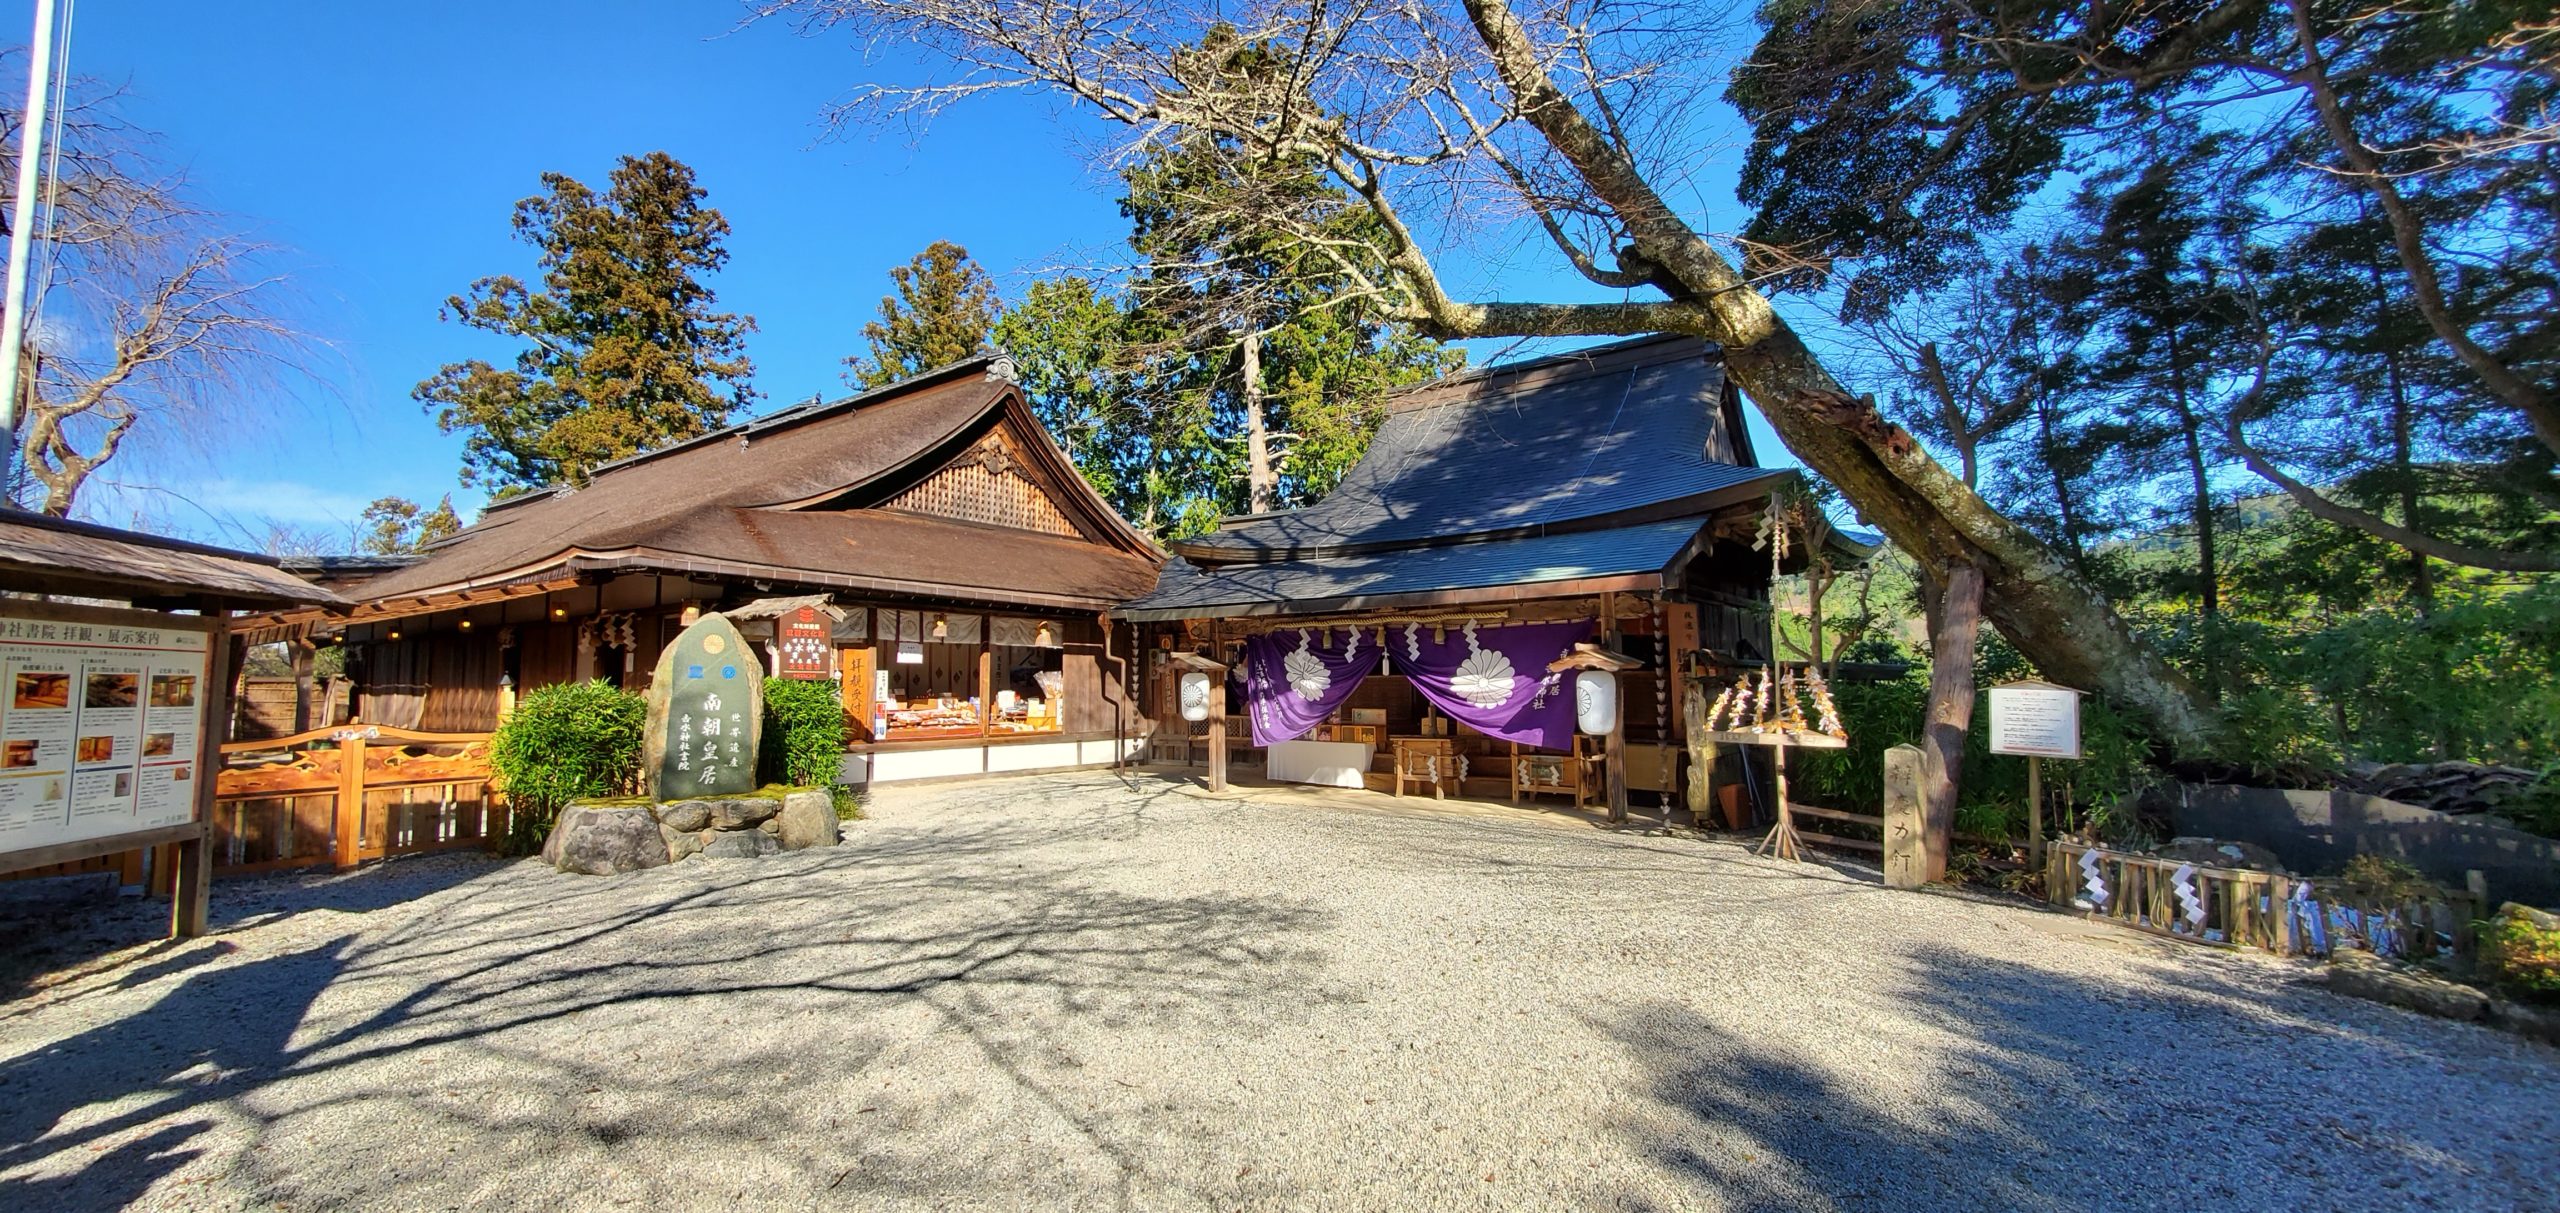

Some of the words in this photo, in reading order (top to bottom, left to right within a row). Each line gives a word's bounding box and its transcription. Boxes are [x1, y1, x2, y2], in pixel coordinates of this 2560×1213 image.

[63, 625, 160, 645] 拝観・展示案内
[849, 658, 865, 714] 拝観受付
[677, 713, 691, 771] 吉水神社書院
[698, 691, 722, 785] 南朝皇居
[728, 712, 742, 768] 世界遺産
